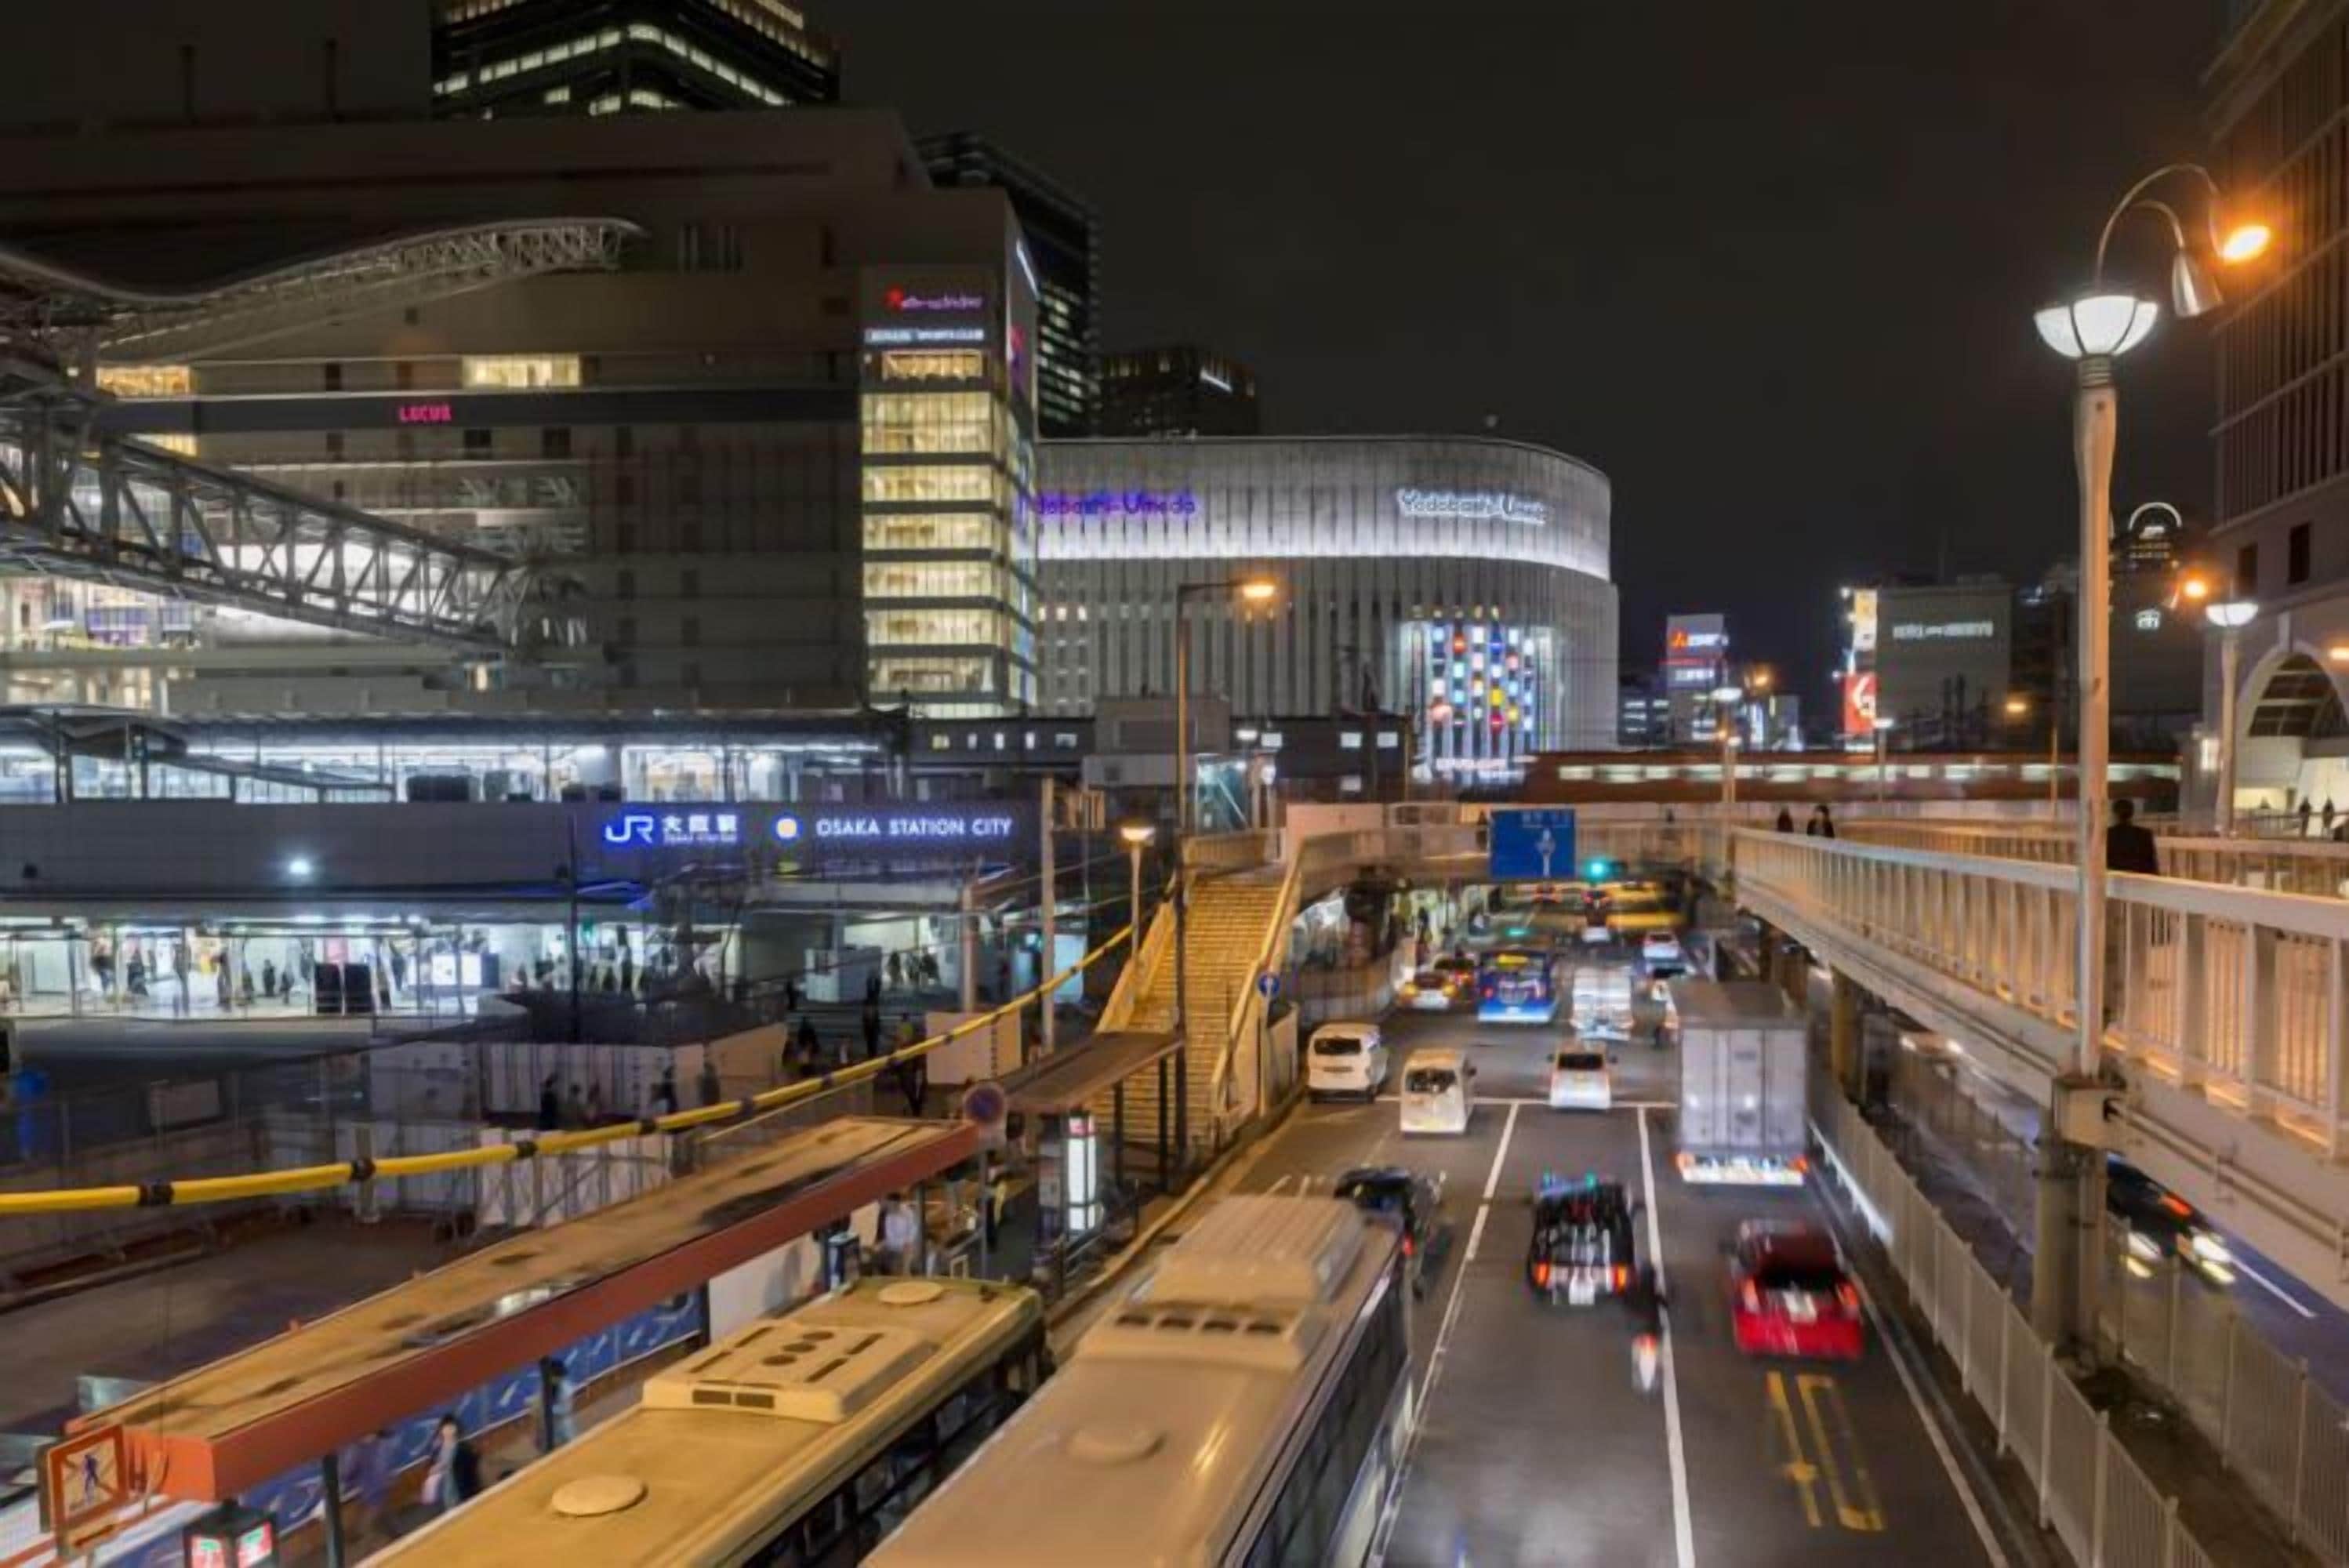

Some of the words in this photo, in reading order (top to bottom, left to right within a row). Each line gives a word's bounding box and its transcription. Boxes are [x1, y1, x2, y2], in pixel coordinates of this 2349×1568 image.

[605, 815, 653, 844] JR
[815, 817, 880, 837] OSAKA
[889, 817, 965, 837] STATION
[971, 817, 1012, 837] CITY
